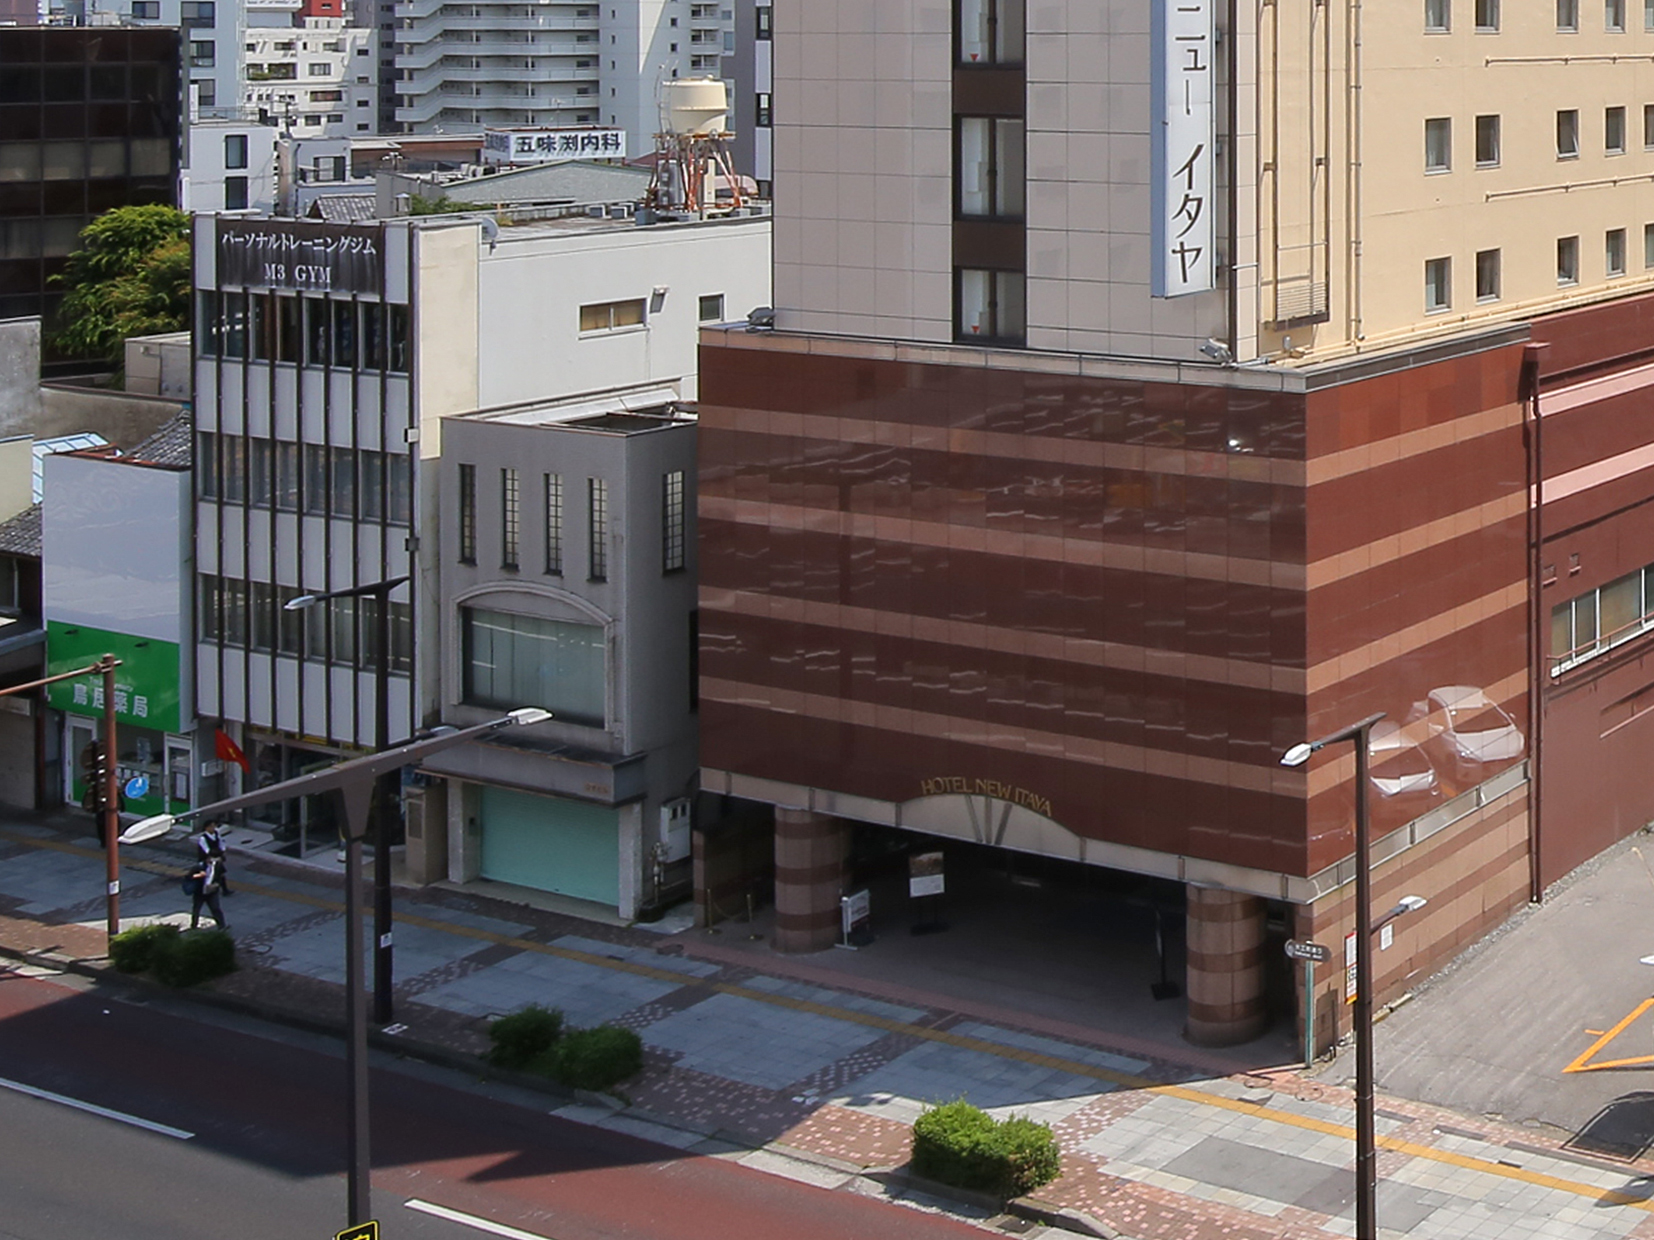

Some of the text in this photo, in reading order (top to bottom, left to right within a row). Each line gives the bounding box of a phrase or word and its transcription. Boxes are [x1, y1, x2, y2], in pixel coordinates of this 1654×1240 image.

[1174, 6, 1207, 116] ニュー
[1171, 143, 1205, 284] イタヤ
[222, 230, 377, 255] パーソナルトレーニングジム
[264, 263, 332, 284] M3 GYM
[920, 776, 1052, 817] HOTEL NEW ITAYA
